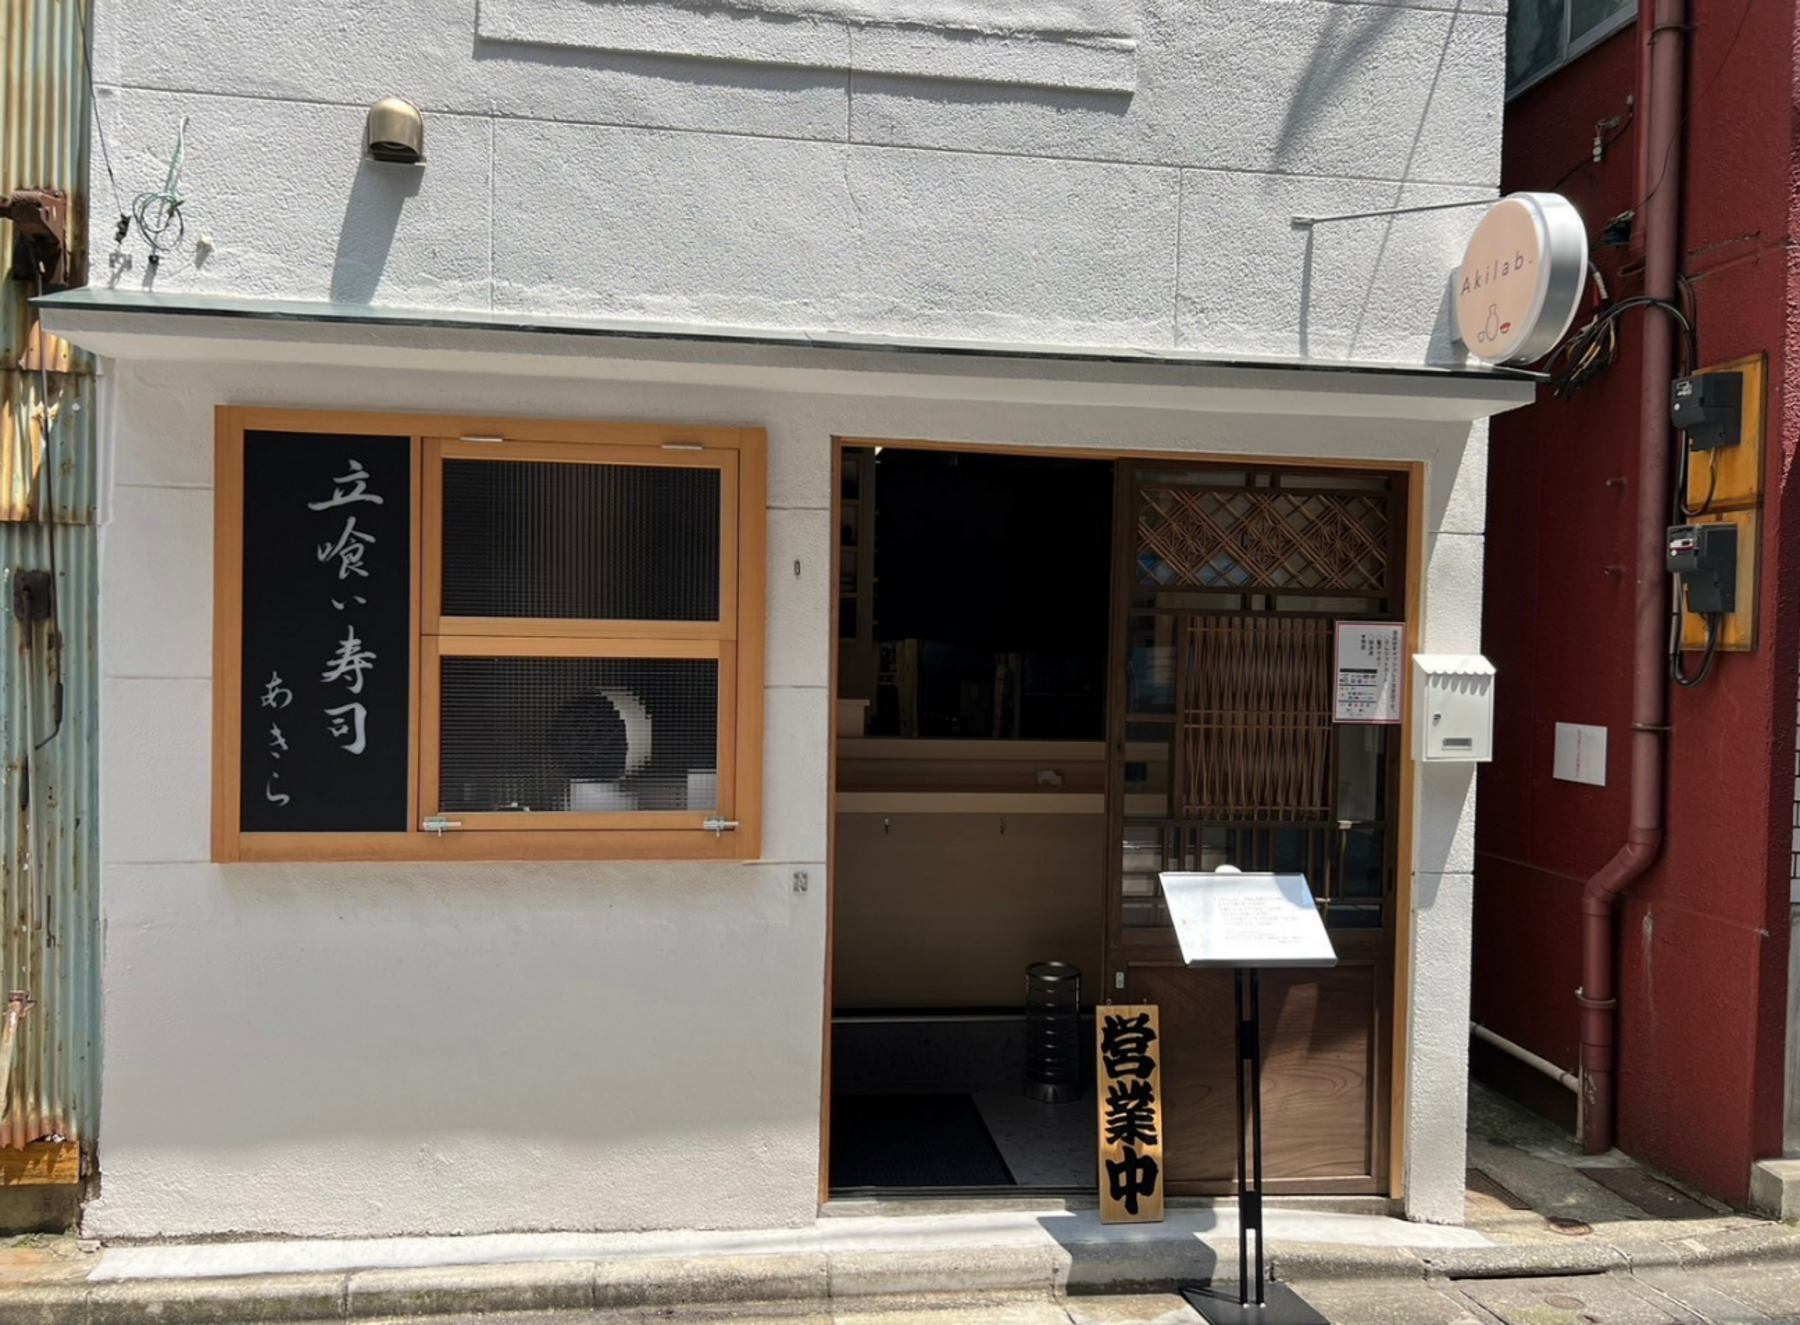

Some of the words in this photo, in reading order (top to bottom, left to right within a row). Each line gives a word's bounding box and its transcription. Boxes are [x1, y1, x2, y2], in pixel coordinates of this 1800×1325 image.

[307, 458, 384, 756] 立喰い寿司
[260, 670, 294, 808] あきら
[1101, 1011, 1160, 1216] 営業中
